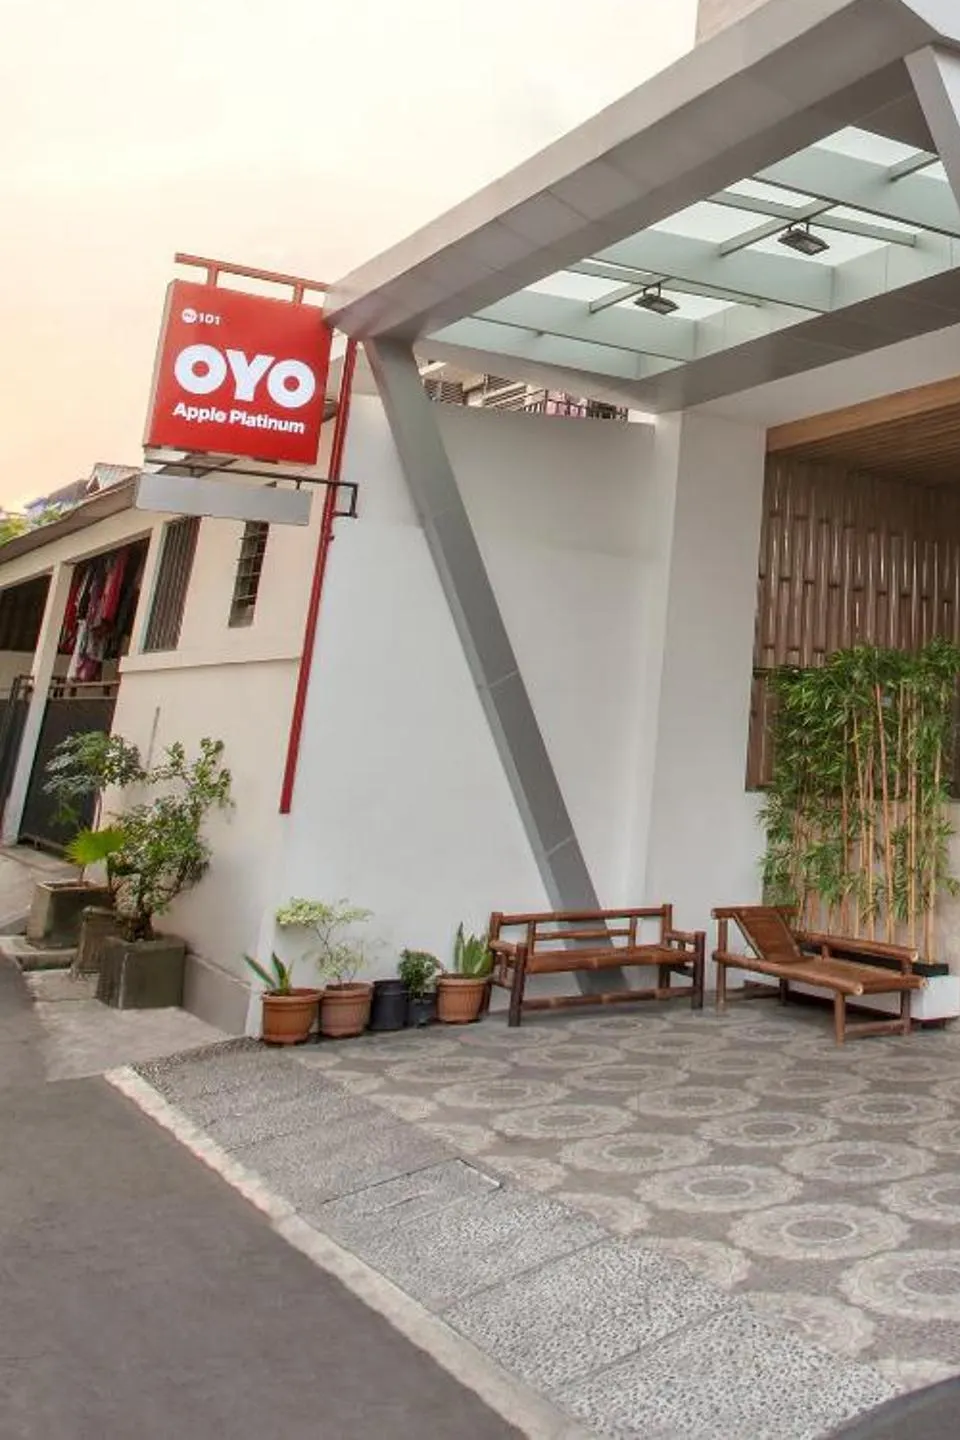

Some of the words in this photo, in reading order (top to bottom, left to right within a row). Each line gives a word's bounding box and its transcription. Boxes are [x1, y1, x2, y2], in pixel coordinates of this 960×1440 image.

[199, 312, 220, 326] 101
[174, 344, 316, 408] OYO
[172, 402, 227, 423] Apple
[229, 409, 305, 434] Platinum
